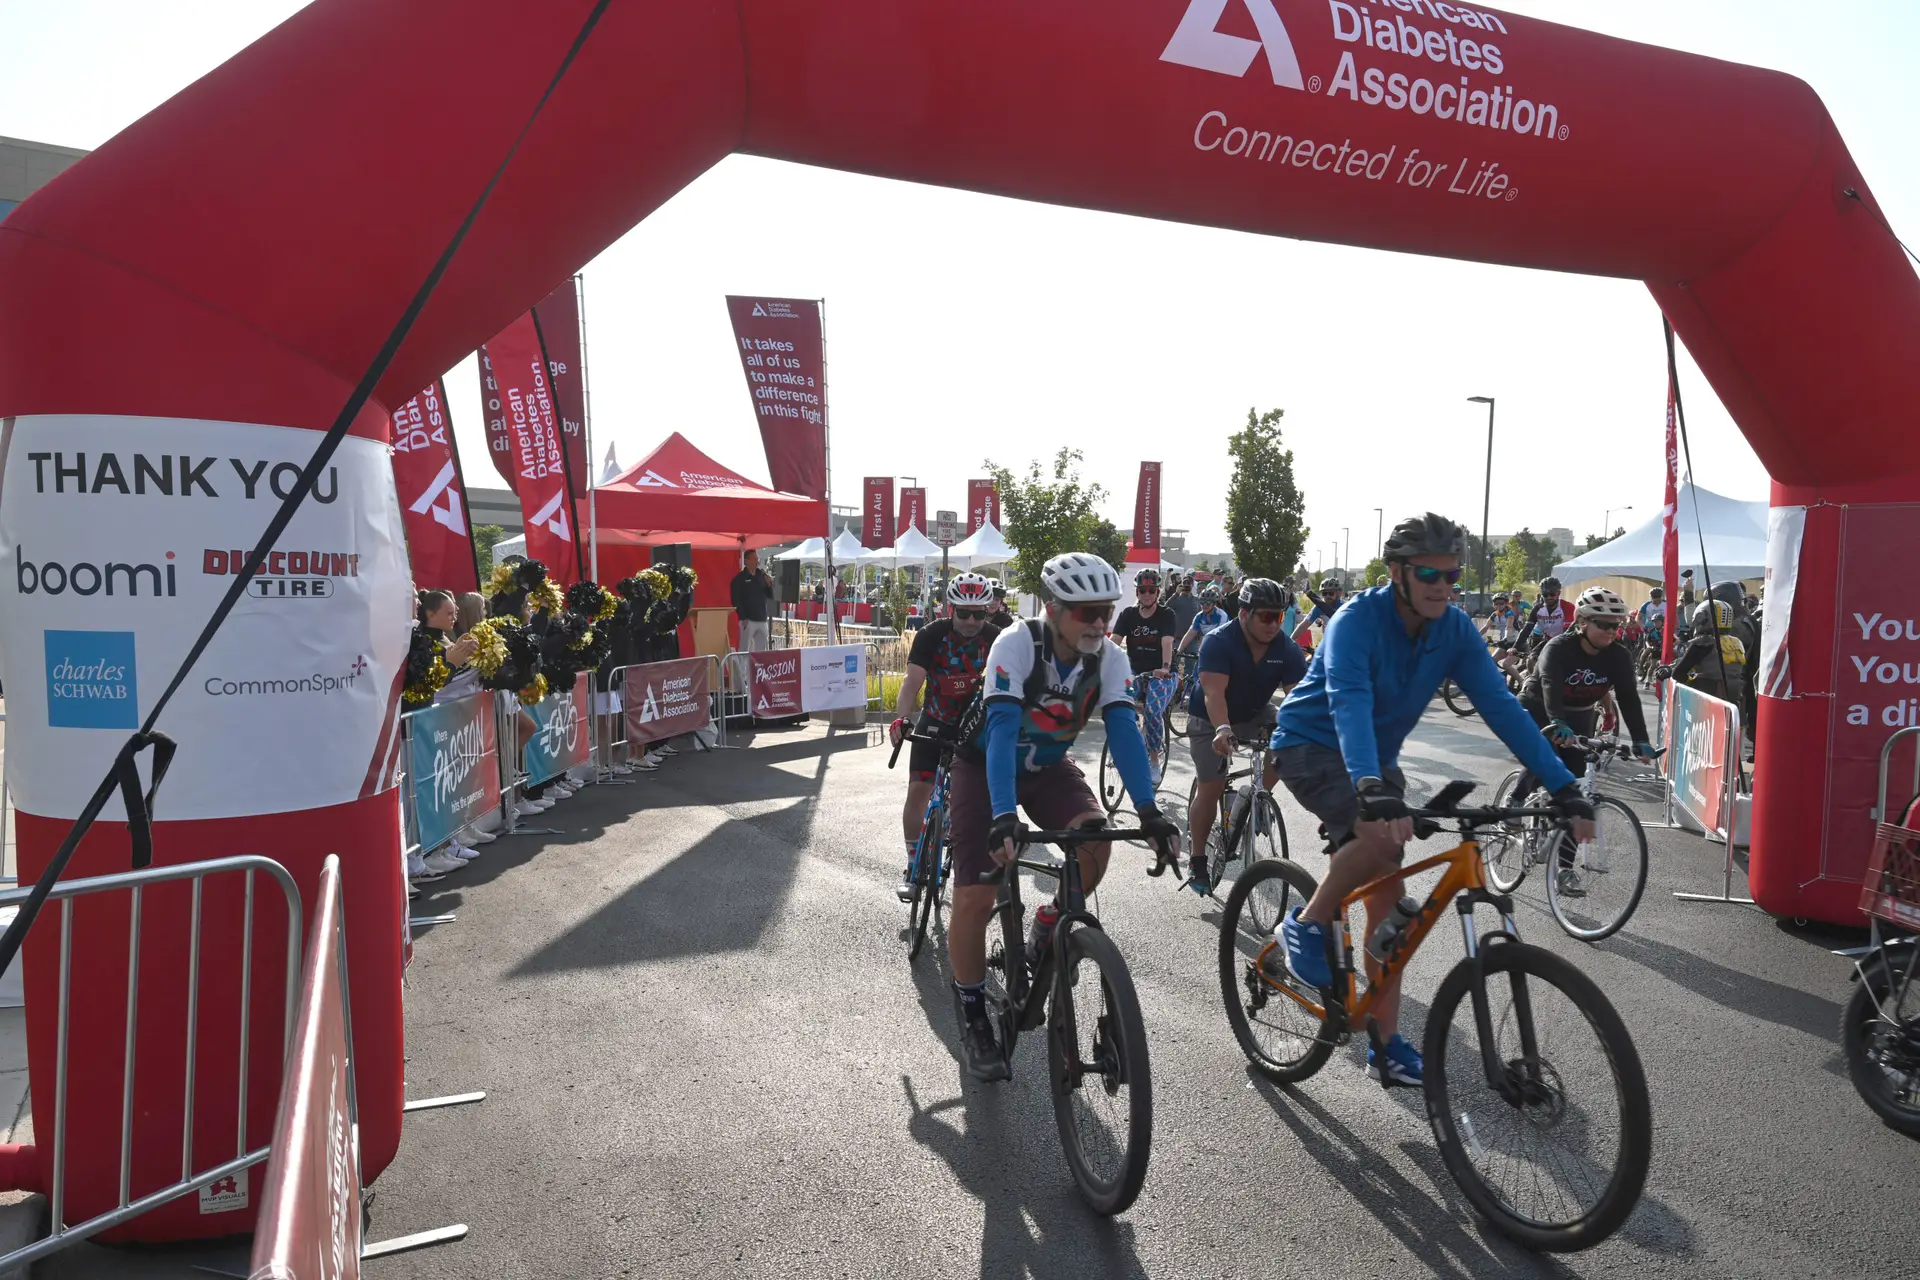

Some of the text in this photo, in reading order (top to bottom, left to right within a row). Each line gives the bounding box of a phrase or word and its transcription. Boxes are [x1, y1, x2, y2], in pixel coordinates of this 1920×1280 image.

[1369, 0, 1508, 35] erican
[1328, 1, 1505, 75] Diabetes
[1326, 51, 1558, 139] Association
[1193, 110, 1510, 199] Connected for Life
[740, 337, 794, 352] It takes
[746, 354, 800, 368] all of us
[750, 370, 815, 387] to make a
[755, 386, 819, 405] difference
[530, 361, 563, 474] Association
[759, 402, 774, 416] in
[774, 404, 799, 418] this
[507, 387, 537, 480] American
[526, 393, 548, 478] Diabetes
[562, 417, 579, 436] by
[28, 452, 338, 505] THANK YOU
[680, 471, 744, 485] American
[873, 493, 882, 511] Aid
[1143, 477, 1152, 544] Information
[873, 513, 882, 537] First
[17, 544, 177, 597] boomi
[256, 580, 325, 596] TIRE
[53, 656, 125, 681] charles
[755, 658, 796, 684] PASSION
[53, 682, 127, 699] SCHWAB
[204, 672, 356, 695] CommonSpirit
[662, 676, 692, 691] American
[953, 681, 965, 689] 30
[662, 690, 690, 705] Diabetes
[662, 702, 698, 719] Association
[1846, 698, 1920, 727] a di
[433, 729, 448, 744] Where
[433, 707, 485, 813] PASSION
[217, 1191, 246, 1201] VISUALS
